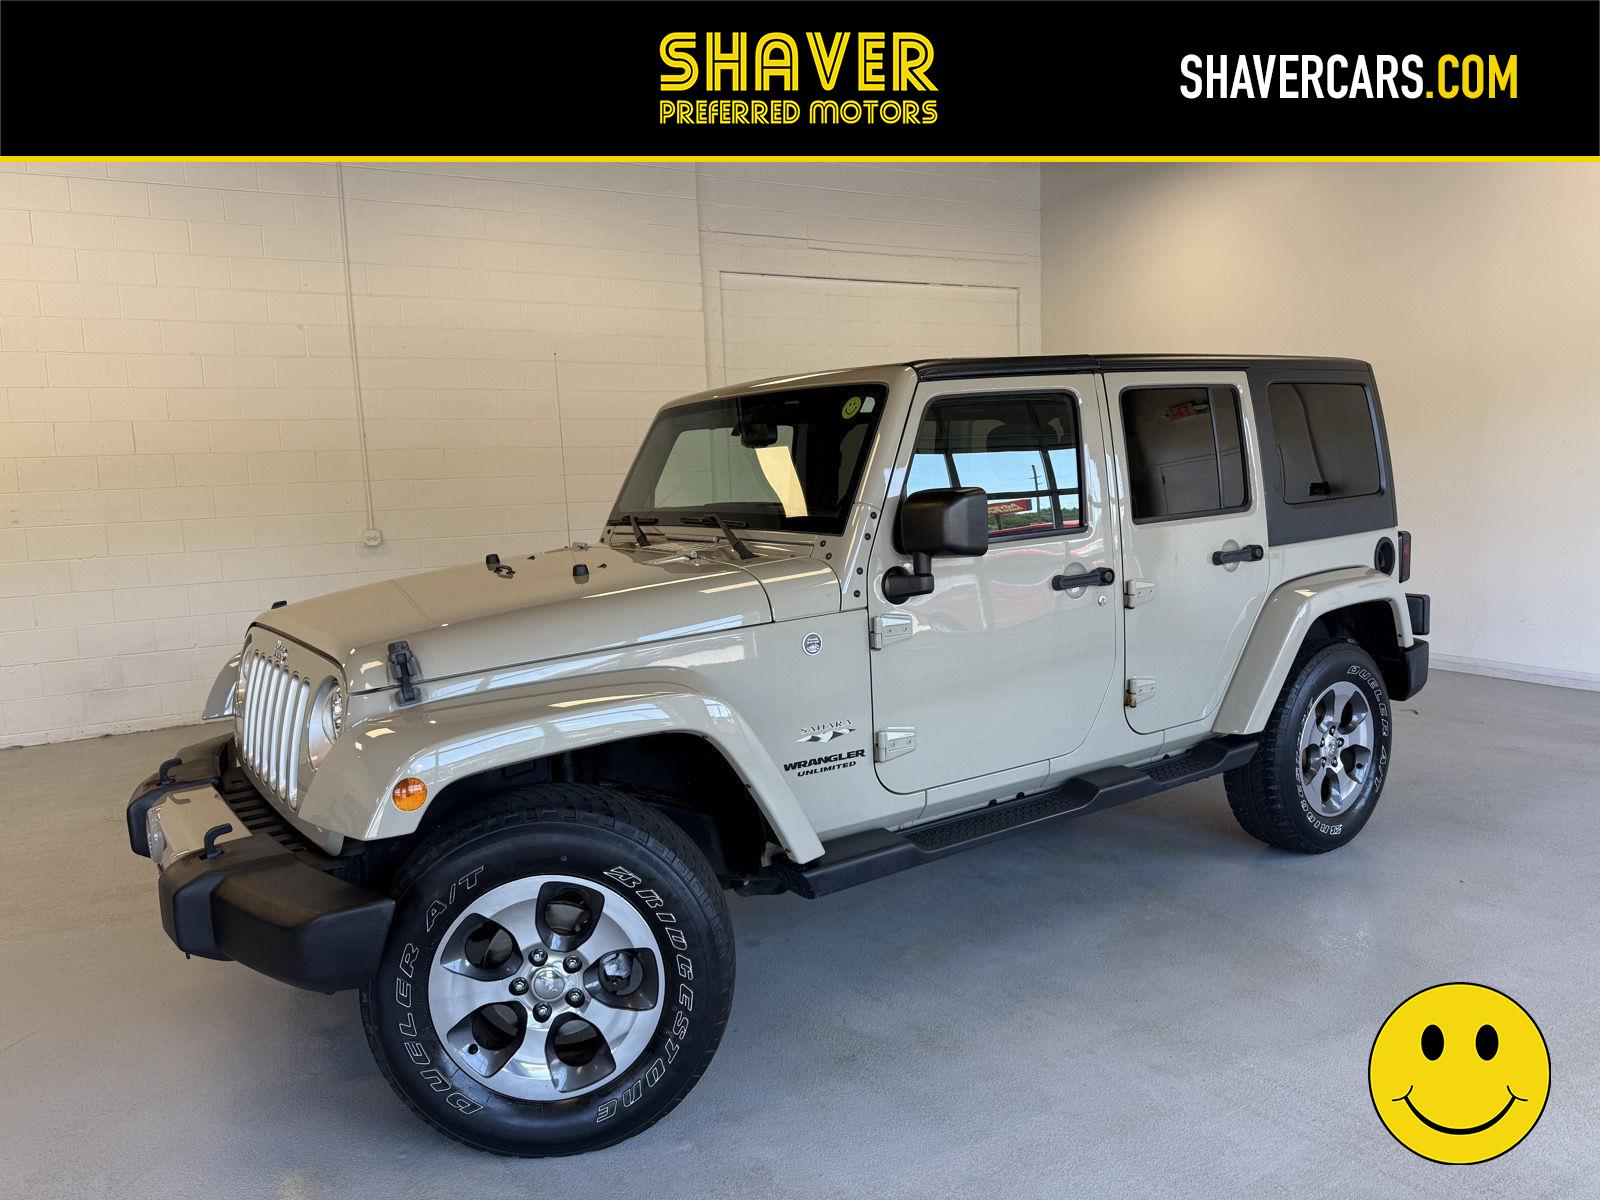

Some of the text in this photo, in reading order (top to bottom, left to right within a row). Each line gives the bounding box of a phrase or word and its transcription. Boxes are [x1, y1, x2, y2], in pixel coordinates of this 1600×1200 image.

[1347, 665, 1389, 737] DUELER
[801, 719, 852, 733] SAHARA
[783, 749, 866, 772] WRANGLER
[797, 761, 857, 777] UNLIMITED
[396, 865, 485, 1115] DUELER A/T
[597, 866, 694, 1123] BRIDGESTONE
